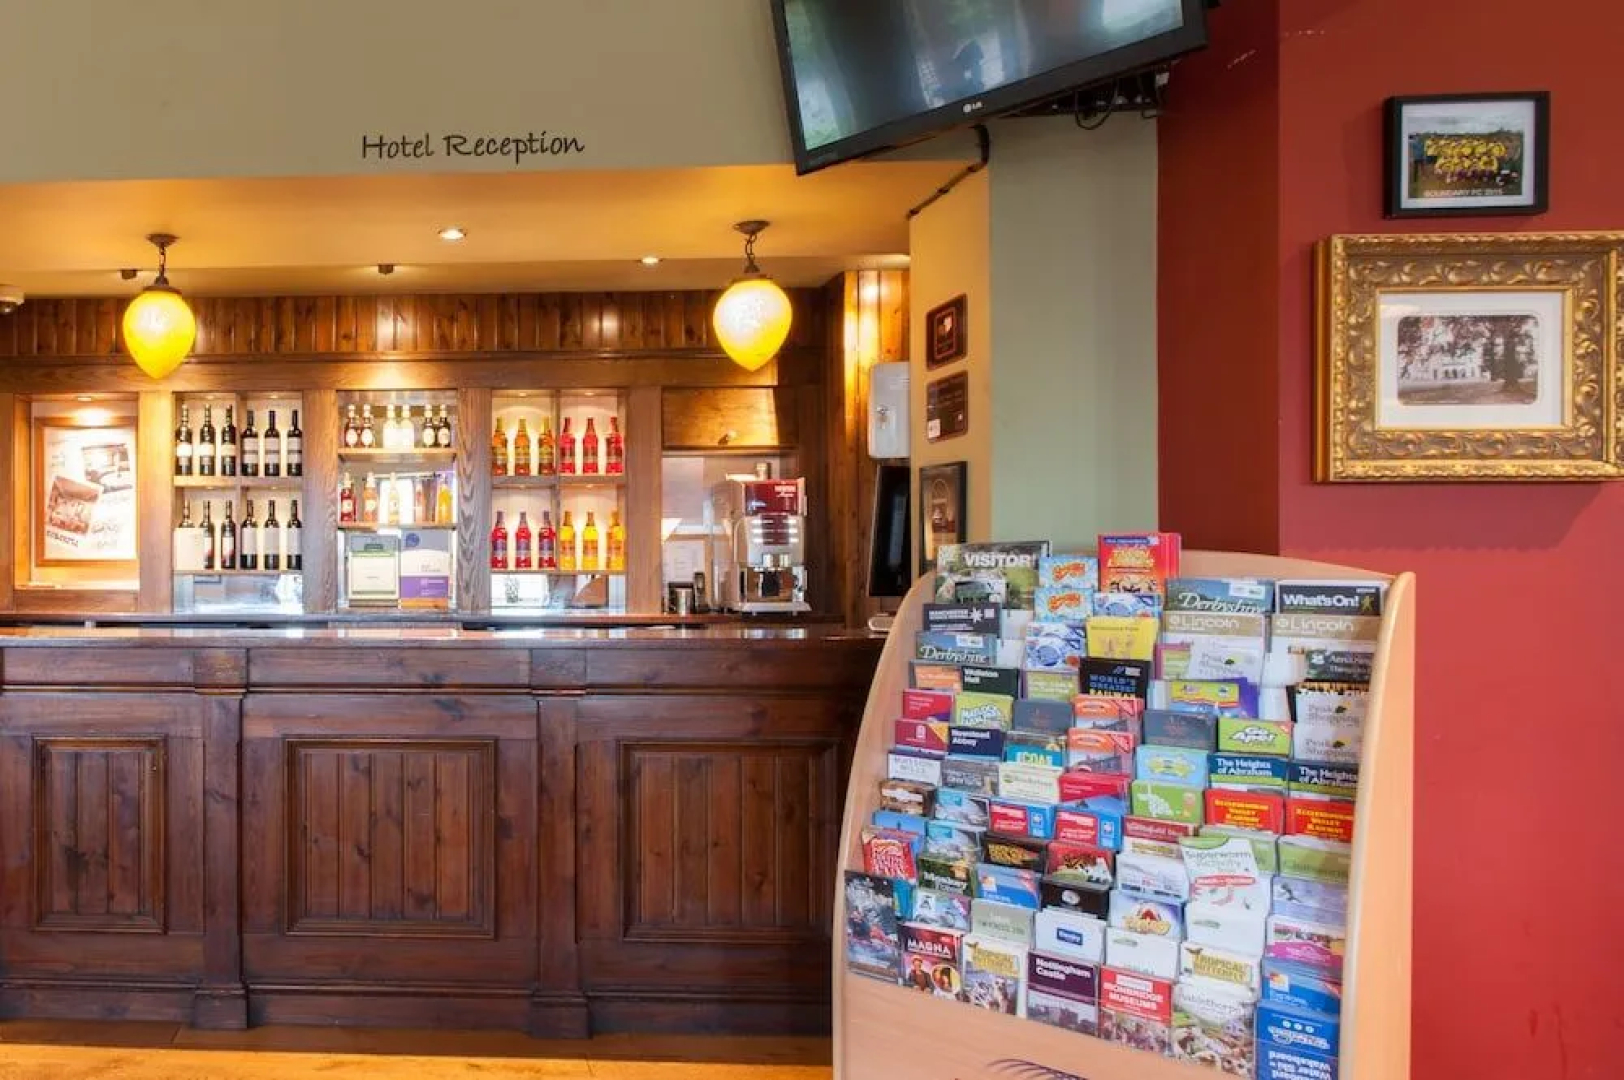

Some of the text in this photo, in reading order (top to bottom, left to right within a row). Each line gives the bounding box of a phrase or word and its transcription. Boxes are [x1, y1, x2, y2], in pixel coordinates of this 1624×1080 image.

[362, 131, 585, 165] Hotel Reception
[1182, 614, 1239, 630] Lincoln
[1291, 616, 1353, 631] Lincoln
[1090, 674, 1136, 685] WORLD'S
[1090, 682, 1136, 692] GREATEST
[1216, 758, 1271, 769] The Heights
[1229, 768, 1272, 776] Abraham
[1299, 766, 1318, 776] The
[1185, 850, 1251, 860] Superworm
[907, 938, 951, 956] MAGNA
[1036, 957, 1091, 978] Nottingham
[1036, 967, 1066, 980] Castle
